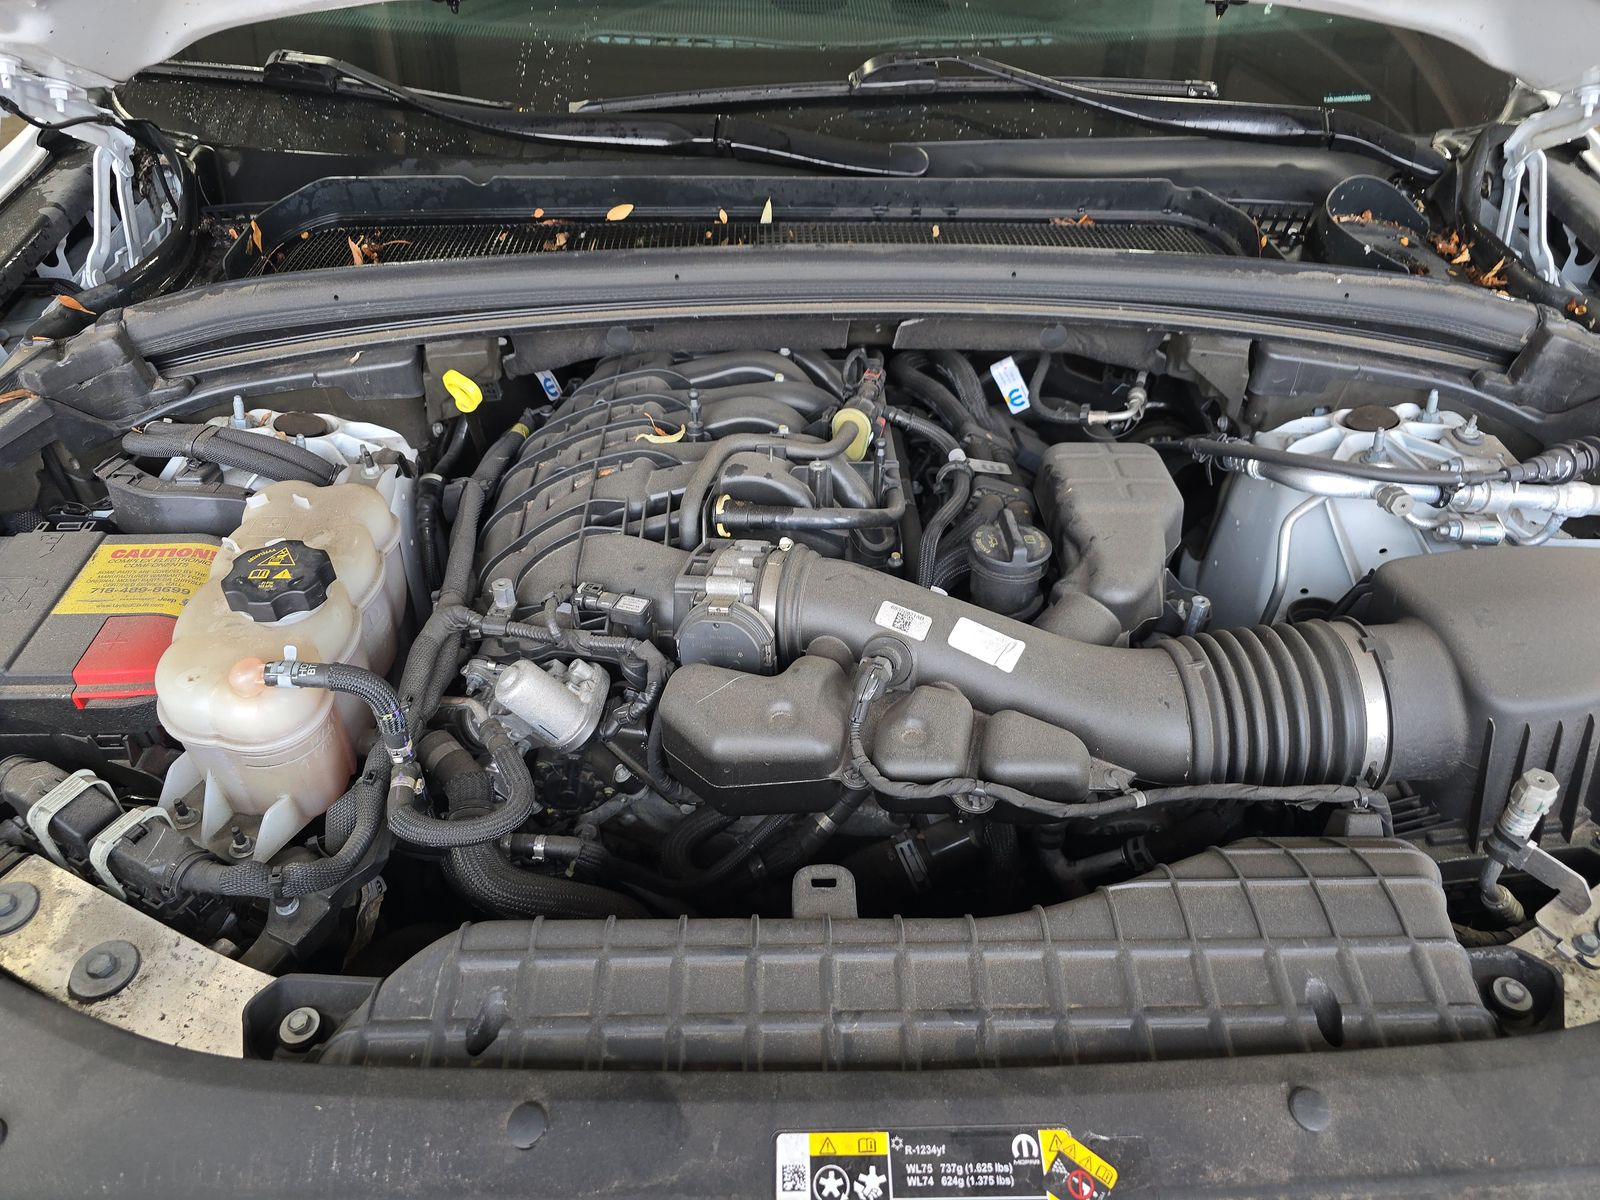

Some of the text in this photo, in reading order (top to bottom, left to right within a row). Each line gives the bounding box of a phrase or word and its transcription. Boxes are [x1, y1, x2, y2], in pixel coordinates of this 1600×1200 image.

[905, 1144, 946, 1157] R-1234yf
[906, 1161, 1013, 1175] WL75 737g (1.625 lbs)
[907, 1175, 1015, 1188] WL74 624g (1.375 lbs)
